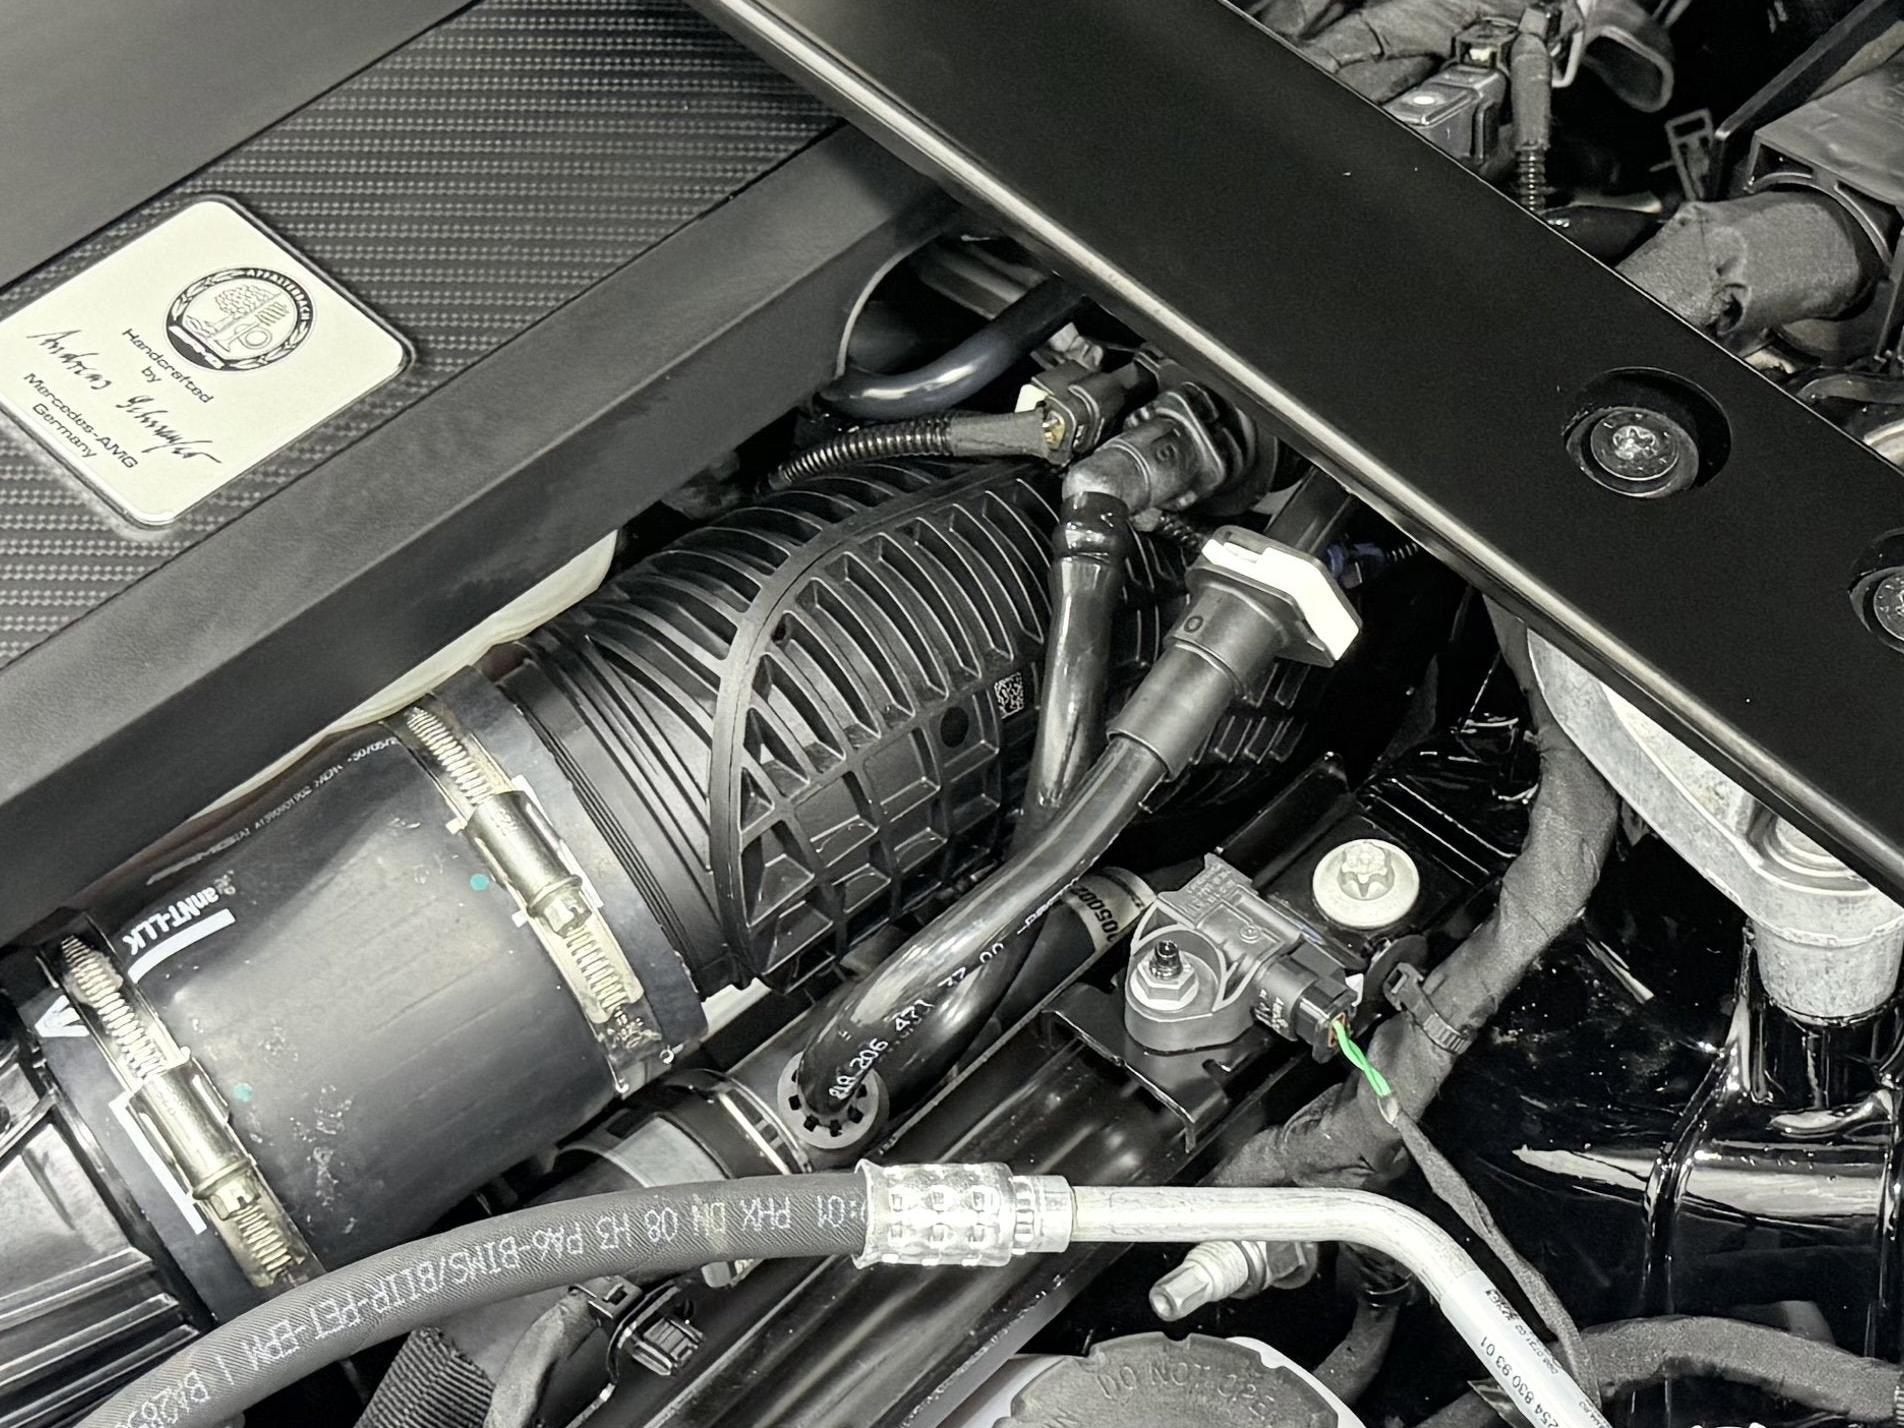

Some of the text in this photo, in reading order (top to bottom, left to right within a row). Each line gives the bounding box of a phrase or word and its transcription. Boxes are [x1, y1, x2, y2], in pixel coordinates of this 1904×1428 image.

[243, 269, 311, 321] AFFALTERBACH
[120, 326, 215, 404] Handcrafted
[139, 364, 162, 384] by
[22, 371, 139, 469] Mercedes-AMG
[30, 401, 100, 459] Germany
[120, 883, 220, 956] anNT-LLK
[848, 1035, 890, 1075] 206
[594, 1212, 632, 1250] H3
[644, 1206, 677, 1242] 08
[691, 1201, 725, 1236] DN
[739, 1196, 790, 1230] PHX
[1477, 1334, 1498, 1356] 01
[1492, 1353, 1514, 1376] 93
[1097, 1366, 1138, 1400] DO
[1508, 1372, 1538, 1404] 830
